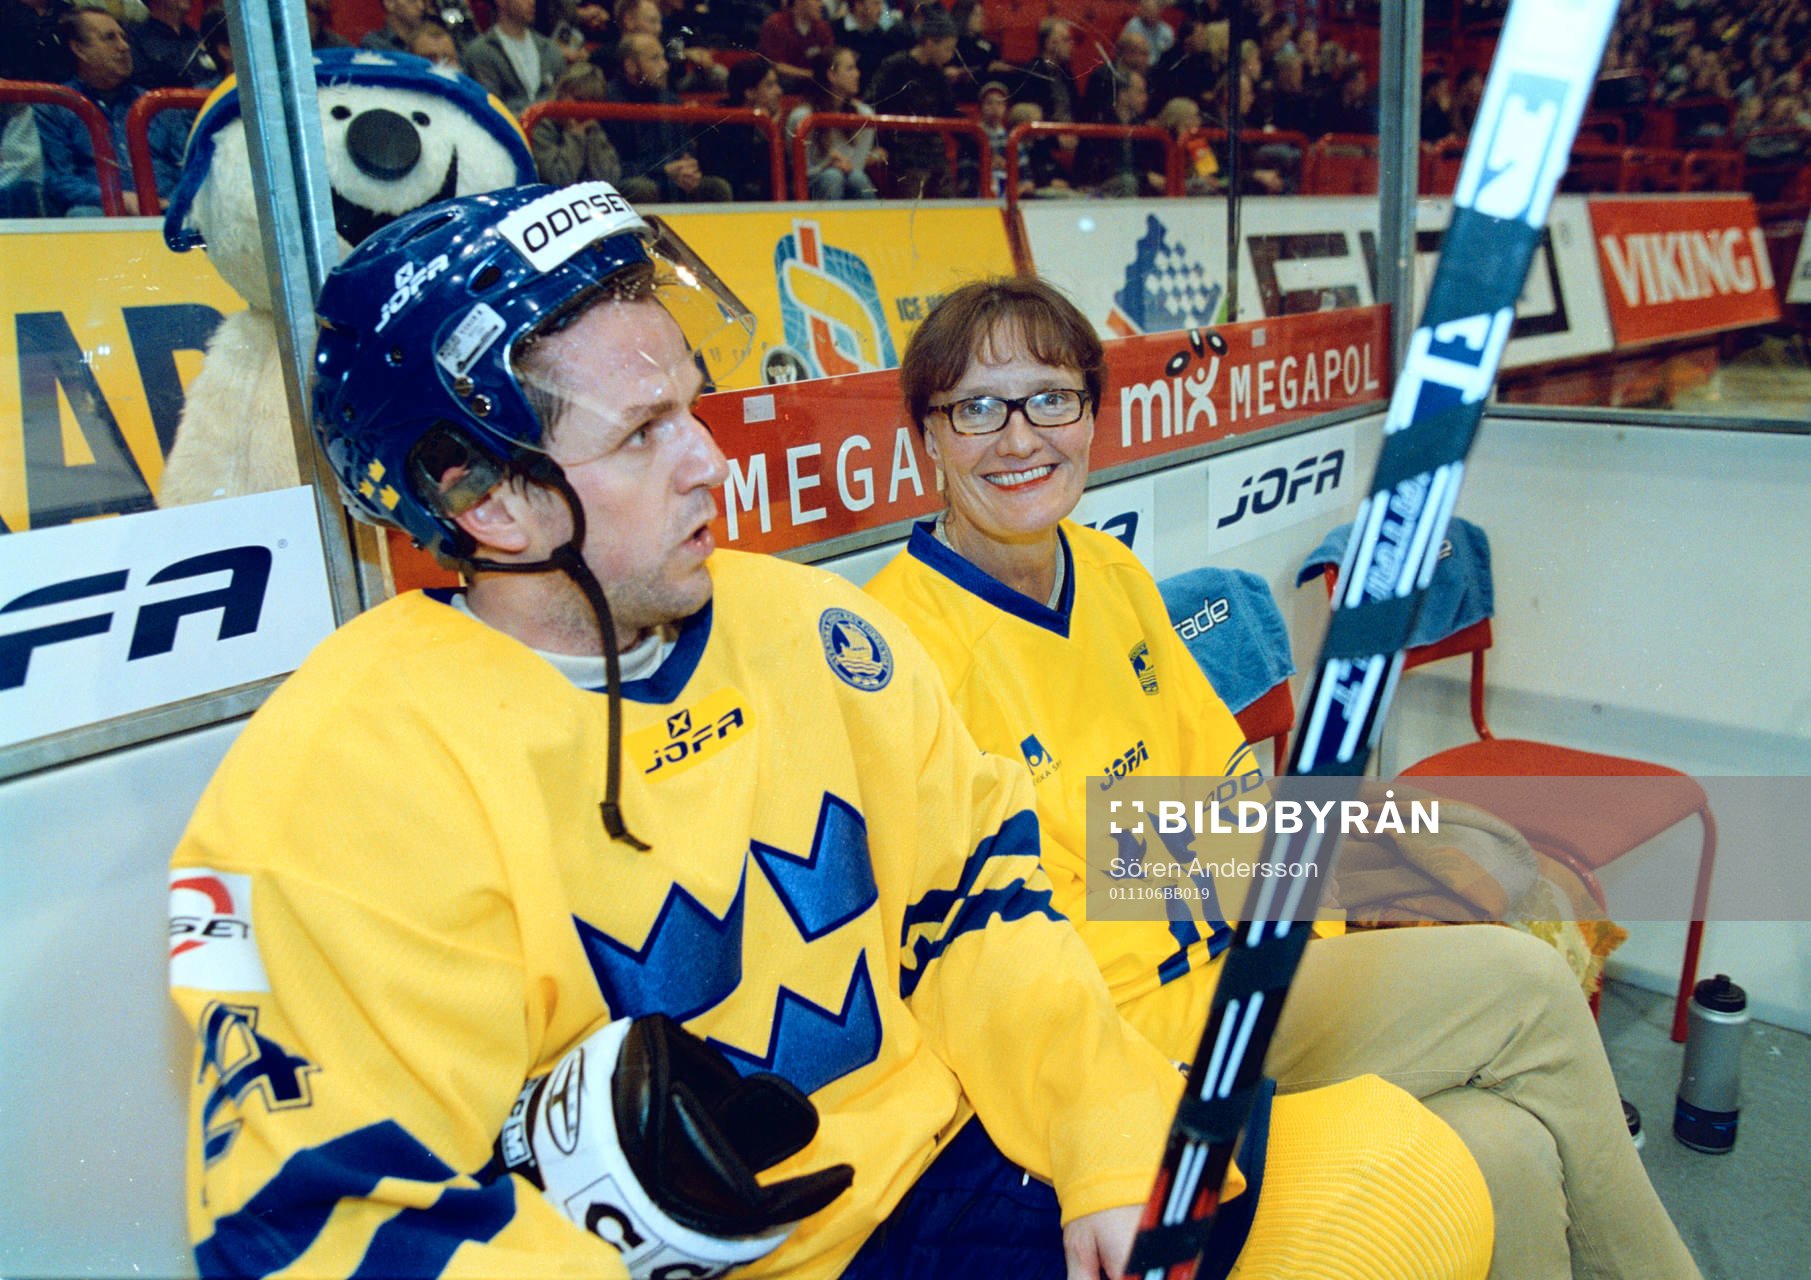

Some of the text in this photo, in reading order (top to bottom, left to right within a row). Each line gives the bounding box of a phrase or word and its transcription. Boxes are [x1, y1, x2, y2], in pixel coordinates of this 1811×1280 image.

[374, 253, 450, 333] JOFA
[1601, 227, 1754, 308] VIKING
[1121, 355, 1220, 448] mix
[1230, 343, 1380, 423] MEGAPOL
[723, 427, 946, 541] MEGA
[1217, 448, 1345, 529] JOFA
[644, 706, 744, 775] JOFA
